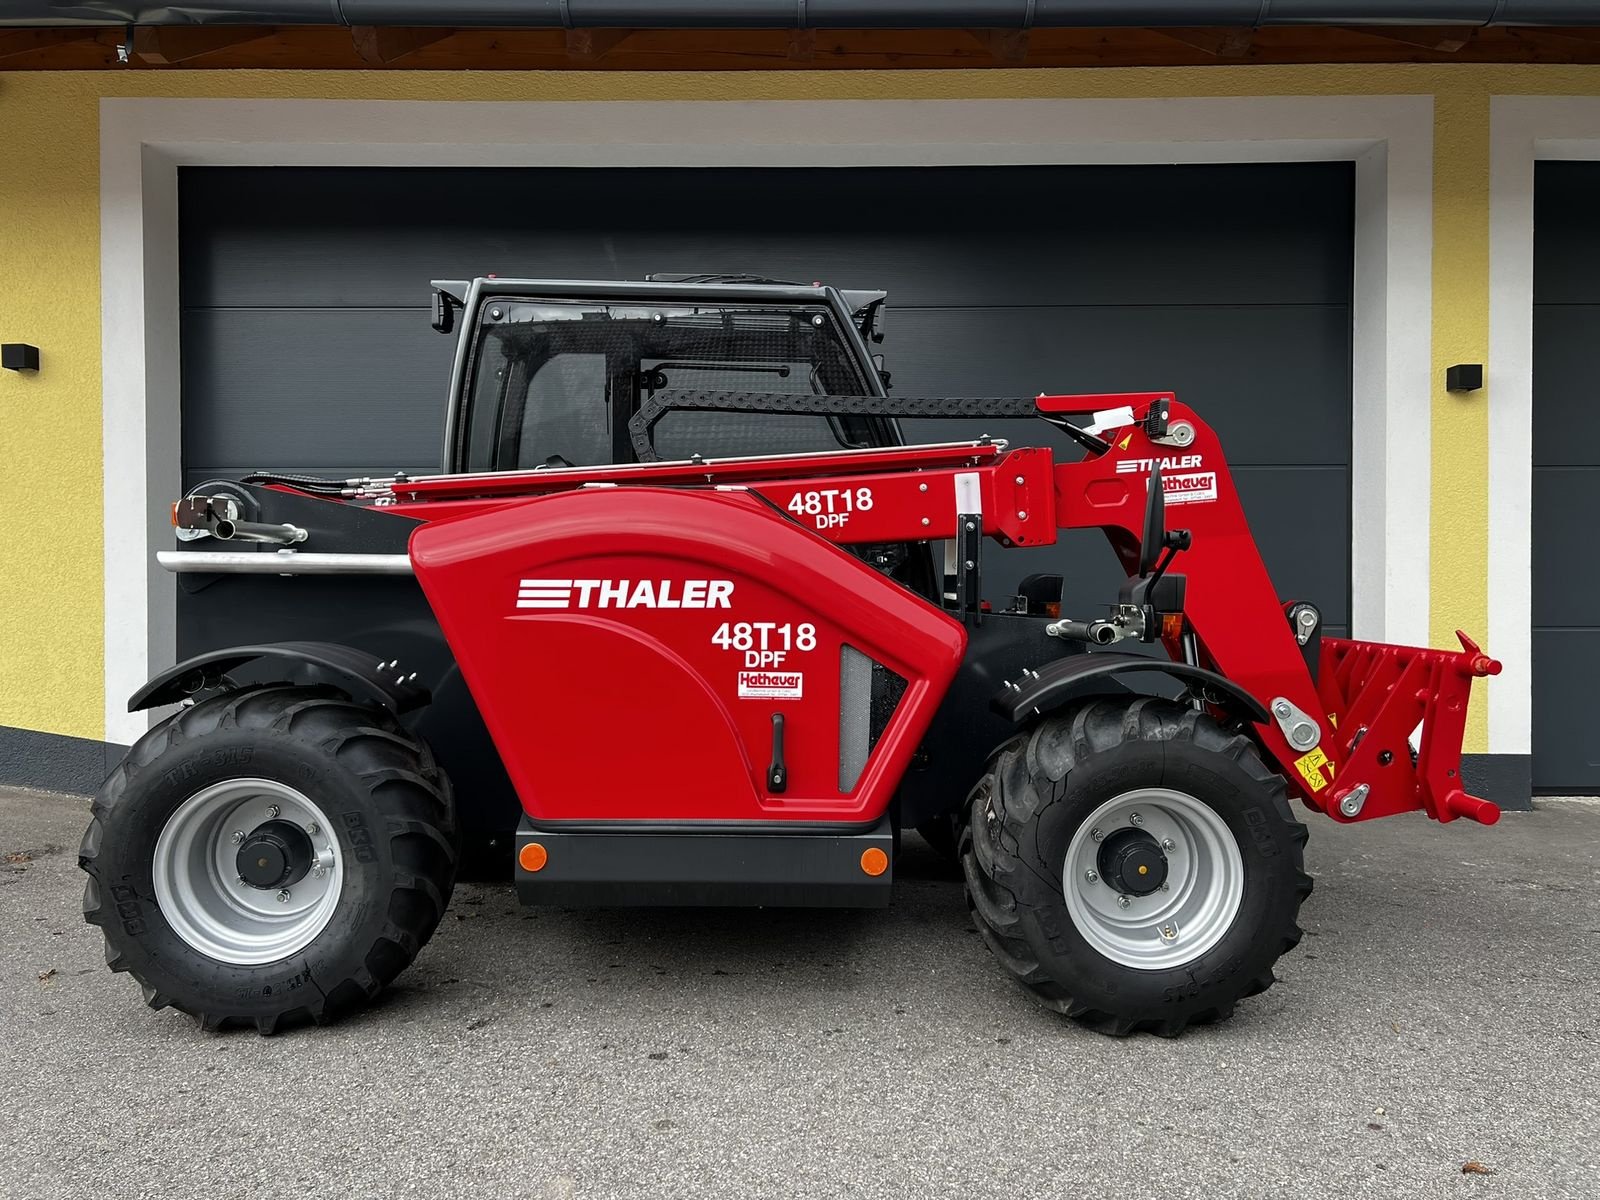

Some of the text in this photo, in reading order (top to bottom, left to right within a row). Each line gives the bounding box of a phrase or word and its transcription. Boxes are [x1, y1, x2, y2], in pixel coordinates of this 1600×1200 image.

[1138, 455, 1202, 471] THALER
[788, 488, 873, 514] 48T18
[816, 513, 850, 529] DPF
[568, 580, 734, 609] THALER
[712, 623, 816, 651] 48T18
[744, 651, 786, 668] DPF
